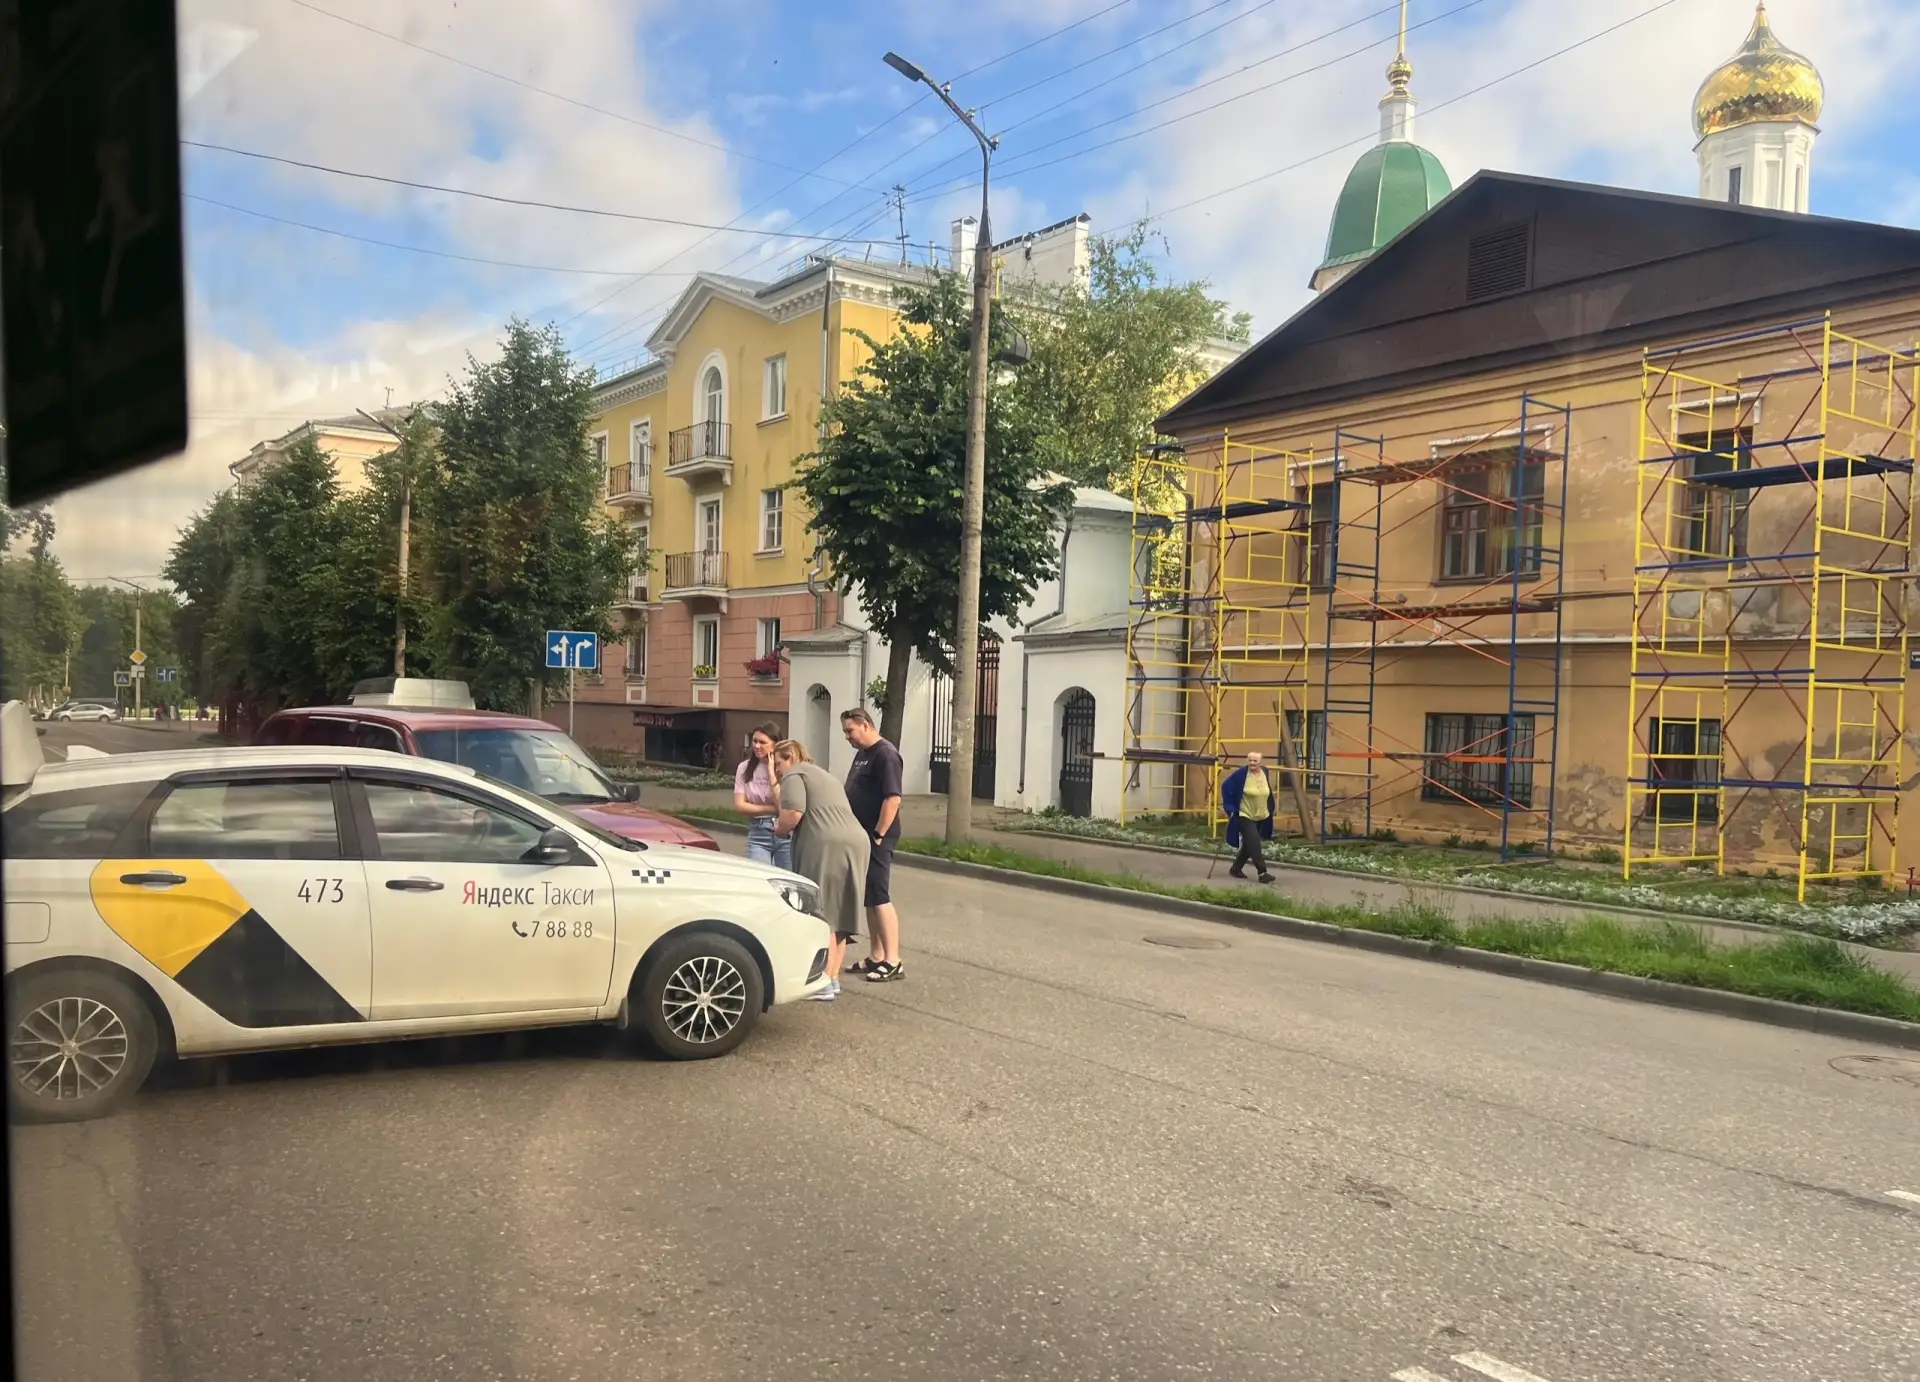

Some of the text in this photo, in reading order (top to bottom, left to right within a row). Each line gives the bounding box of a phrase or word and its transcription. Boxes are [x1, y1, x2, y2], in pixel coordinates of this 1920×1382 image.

[297, 878, 344, 903] 473
[462, 880, 595, 907] Яндекс Такси
[531, 920, 593, 938] 7 88 88
